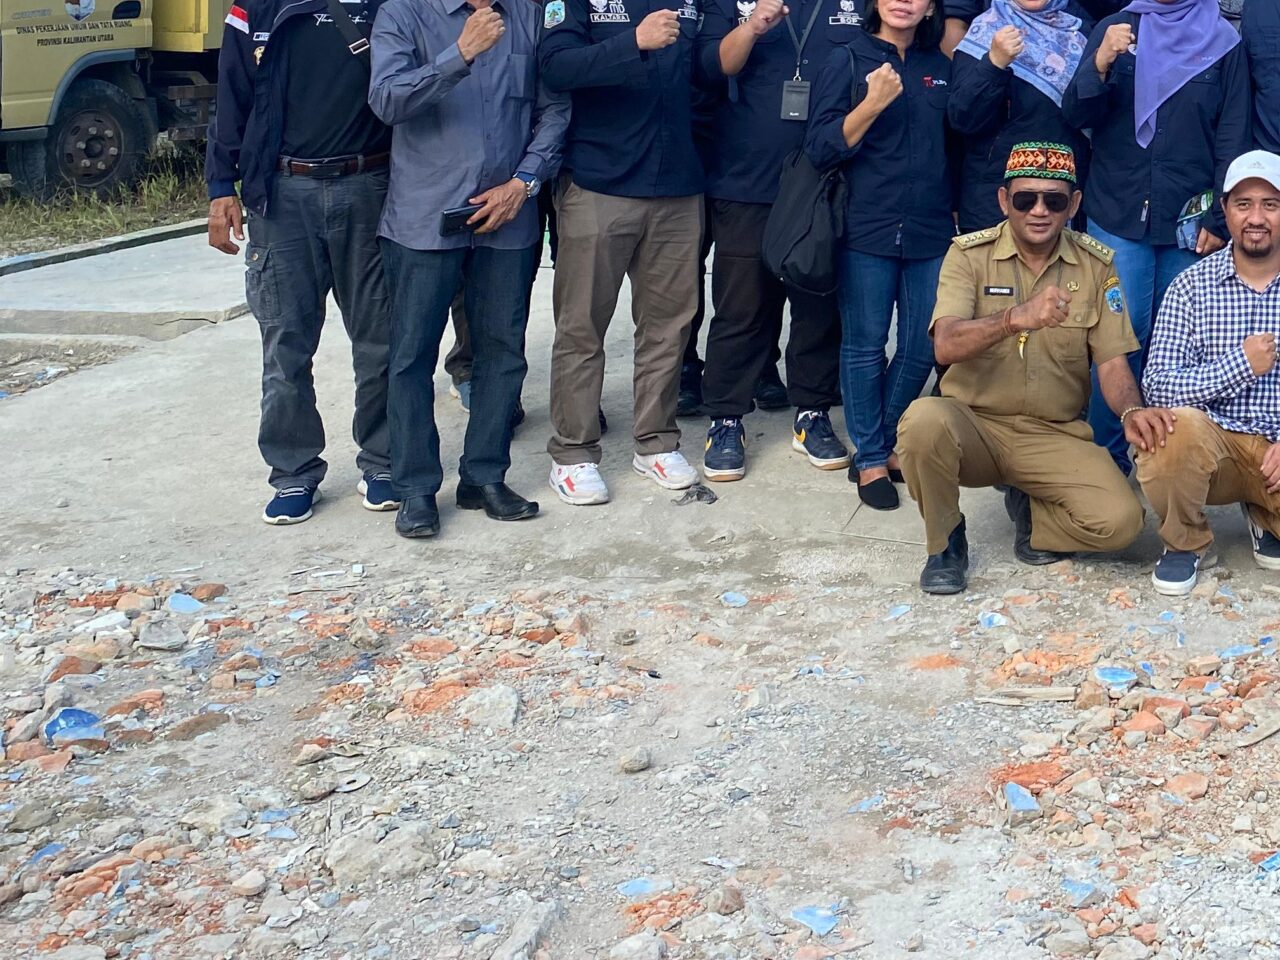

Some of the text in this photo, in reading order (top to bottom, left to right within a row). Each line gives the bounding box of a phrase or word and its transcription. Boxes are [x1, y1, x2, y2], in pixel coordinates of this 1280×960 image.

[16, 26, 35, 34] DINAS
[36, 24, 69, 33] PEKERJAAN
[88, 22, 100, 30] DAN
[100, 21, 113, 29] TATA
[115, 20, 132, 28] RUANG
[37, 34, 114, 46] PROVINSI KALIMANTAN UTARA
